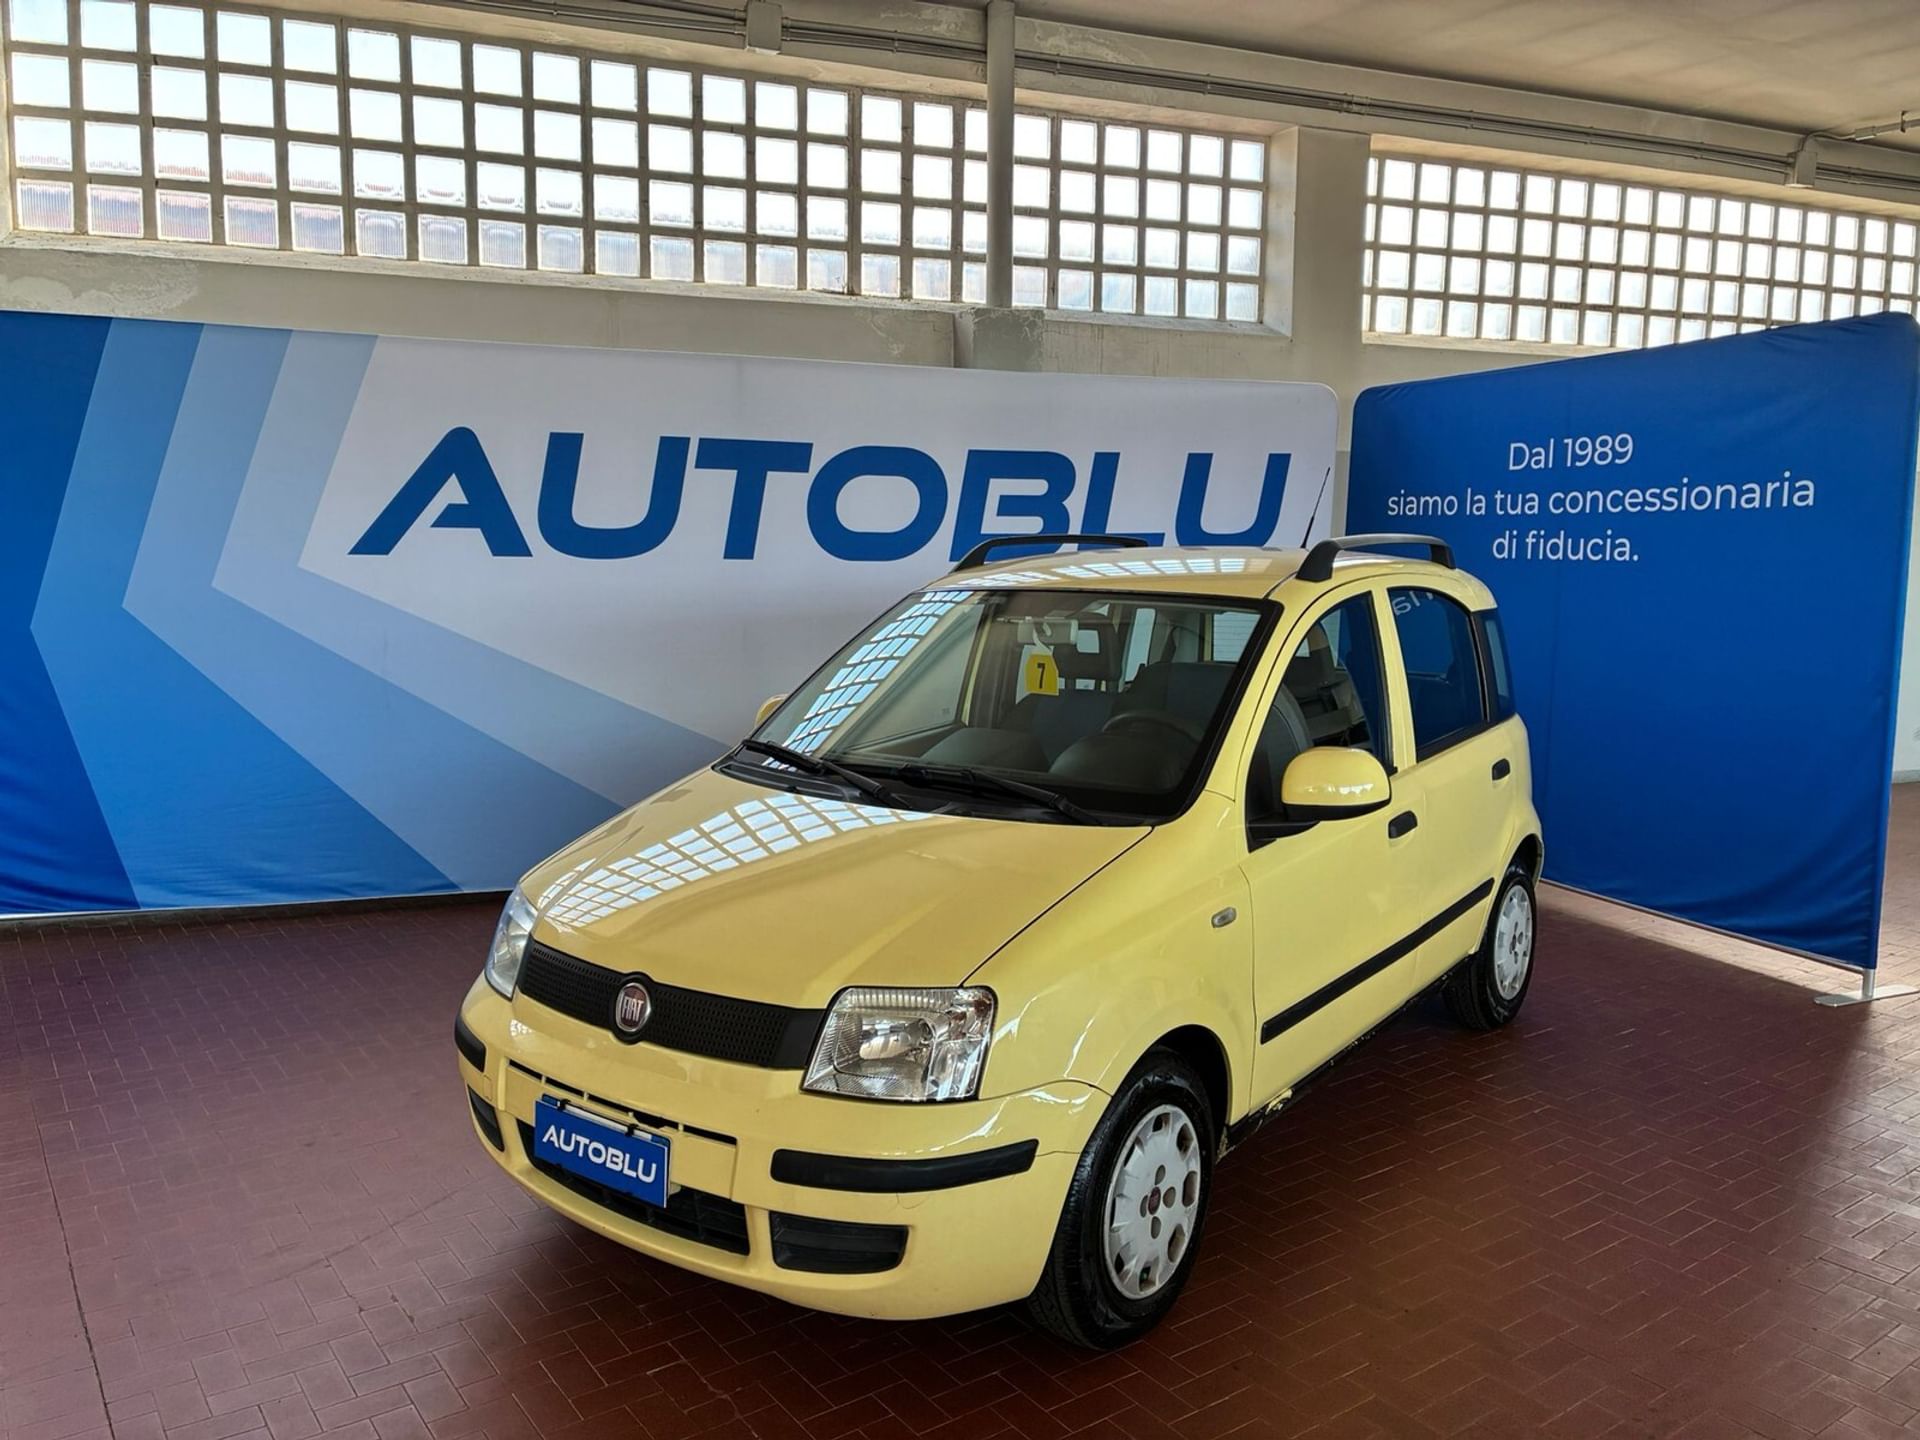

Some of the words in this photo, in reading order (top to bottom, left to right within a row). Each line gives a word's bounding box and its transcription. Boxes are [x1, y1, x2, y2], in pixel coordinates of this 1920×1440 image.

[1508, 439, 1555, 471] Dal
[1563, 433, 1634, 468] 1989
[348, 427, 1292, 563] AUTOBLU
[1387, 489, 1459, 516] siamo
[1465, 487, 1487, 516] la
[1494, 490, 1540, 516] tua
[1548, 470, 1816, 515] concessionaria
[1491, 530, 1517, 560] di
[1525, 530, 1640, 562] fiducia.
[1037, 662, 1046, 689] 7
[621, 995, 645, 1022] FIAT
[541, 1124, 658, 1184] AUTOBLU
